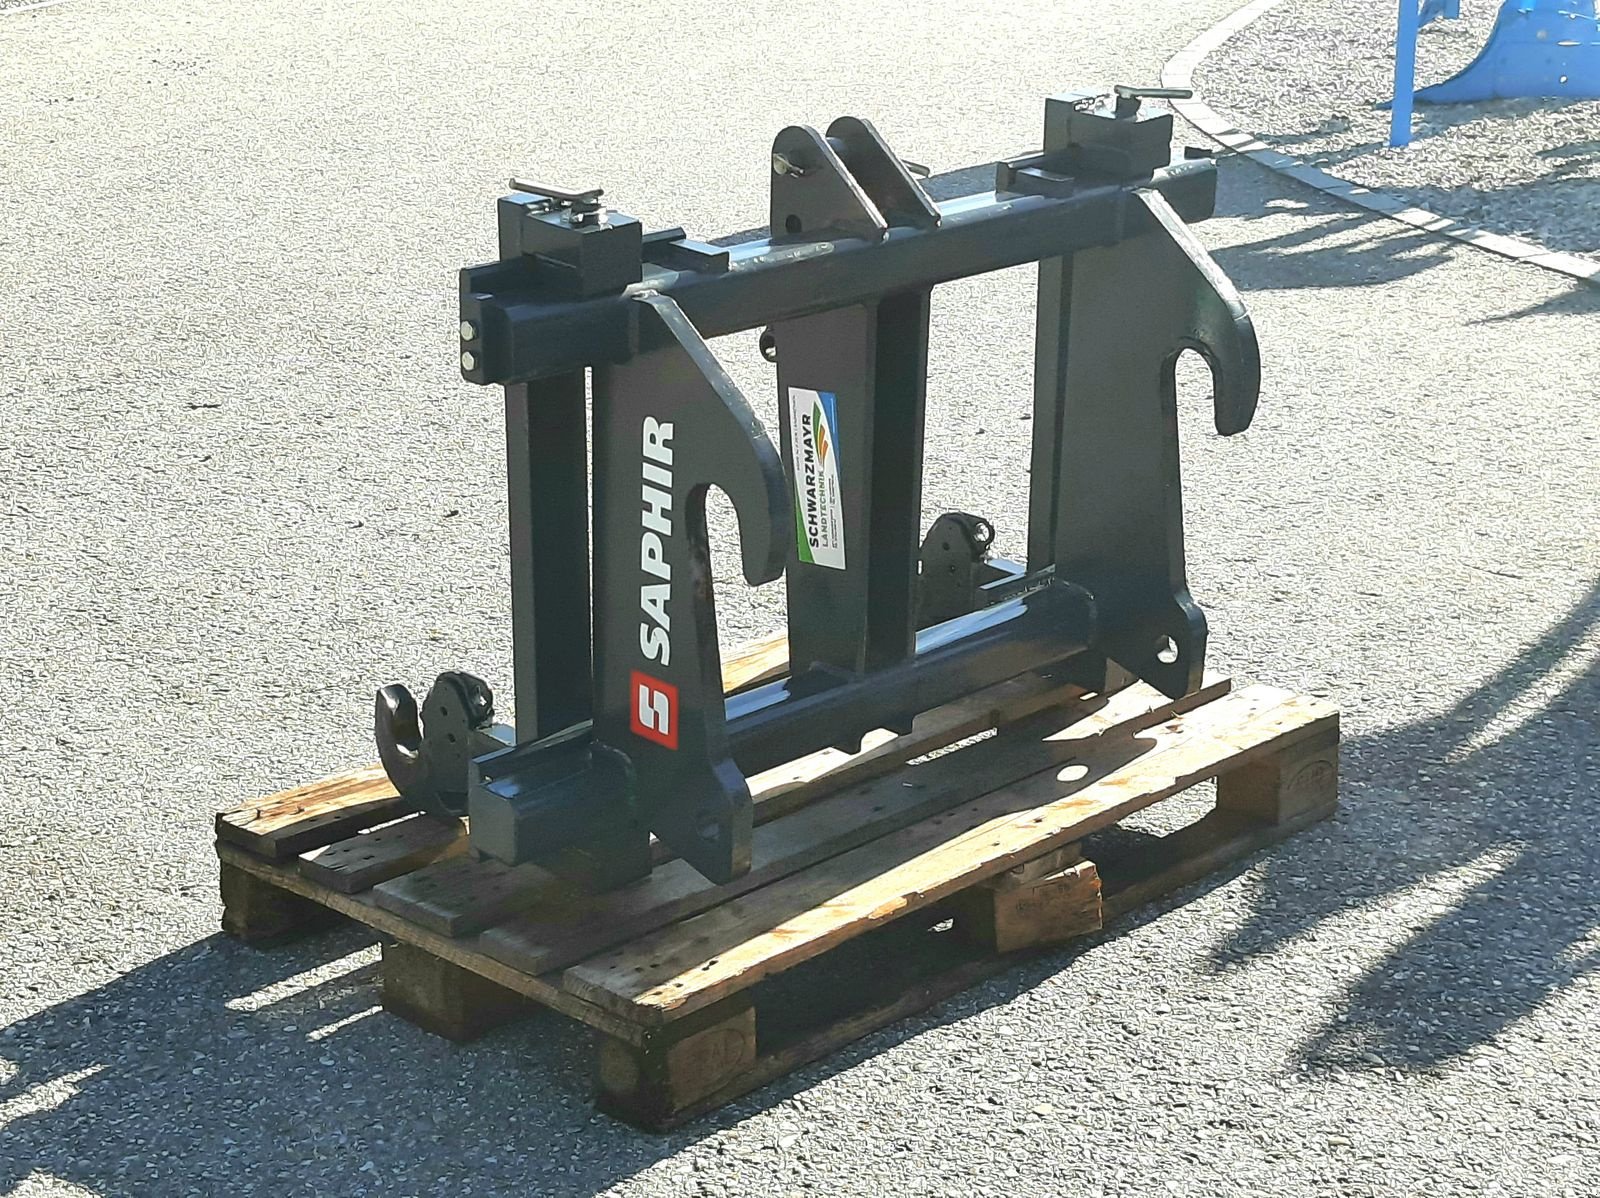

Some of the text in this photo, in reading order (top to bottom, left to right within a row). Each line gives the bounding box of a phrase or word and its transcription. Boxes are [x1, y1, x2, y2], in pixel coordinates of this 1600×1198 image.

[640, 416, 674, 666] SAPHIR
[802, 414, 819, 548] SCHWARZMAYR
[818, 470, 829, 548] LANDTECHNIK
